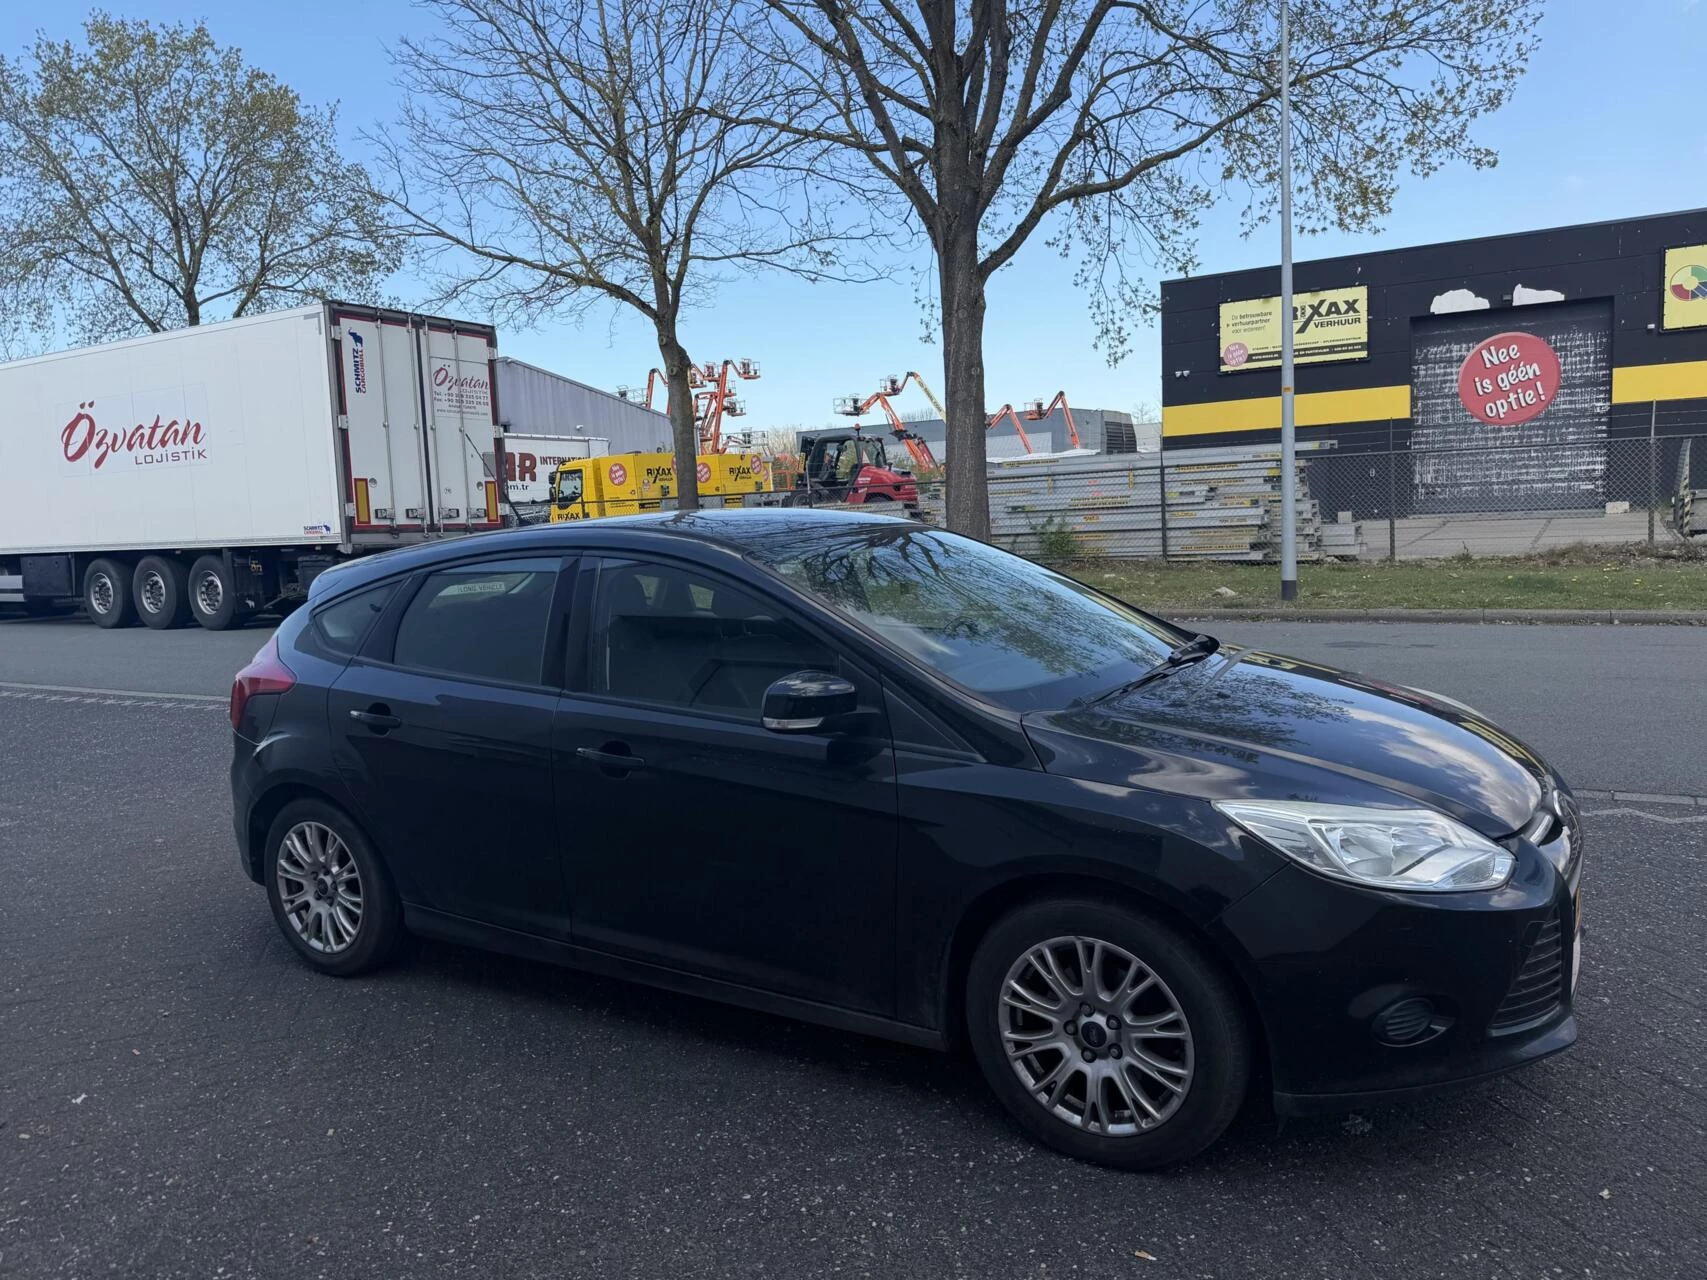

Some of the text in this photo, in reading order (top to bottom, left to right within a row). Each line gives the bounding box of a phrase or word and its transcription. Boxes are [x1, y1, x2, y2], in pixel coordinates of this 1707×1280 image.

[1314, 317, 1361, 328] VERHUUR
[1481, 344, 1520, 368] Nee
[353, 348, 361, 393] SCHMITZ
[432, 364, 489, 391] Özvatan
[1474, 361, 1541, 396] is géén
[61, 400, 206, 469] Özvatan
[135, 447, 208, 465] LOJİSTİK
[646, 466, 672, 484] RIXAX
[728, 465, 752, 481] RIXAX
[557, 511, 580, 521] RIXAX
